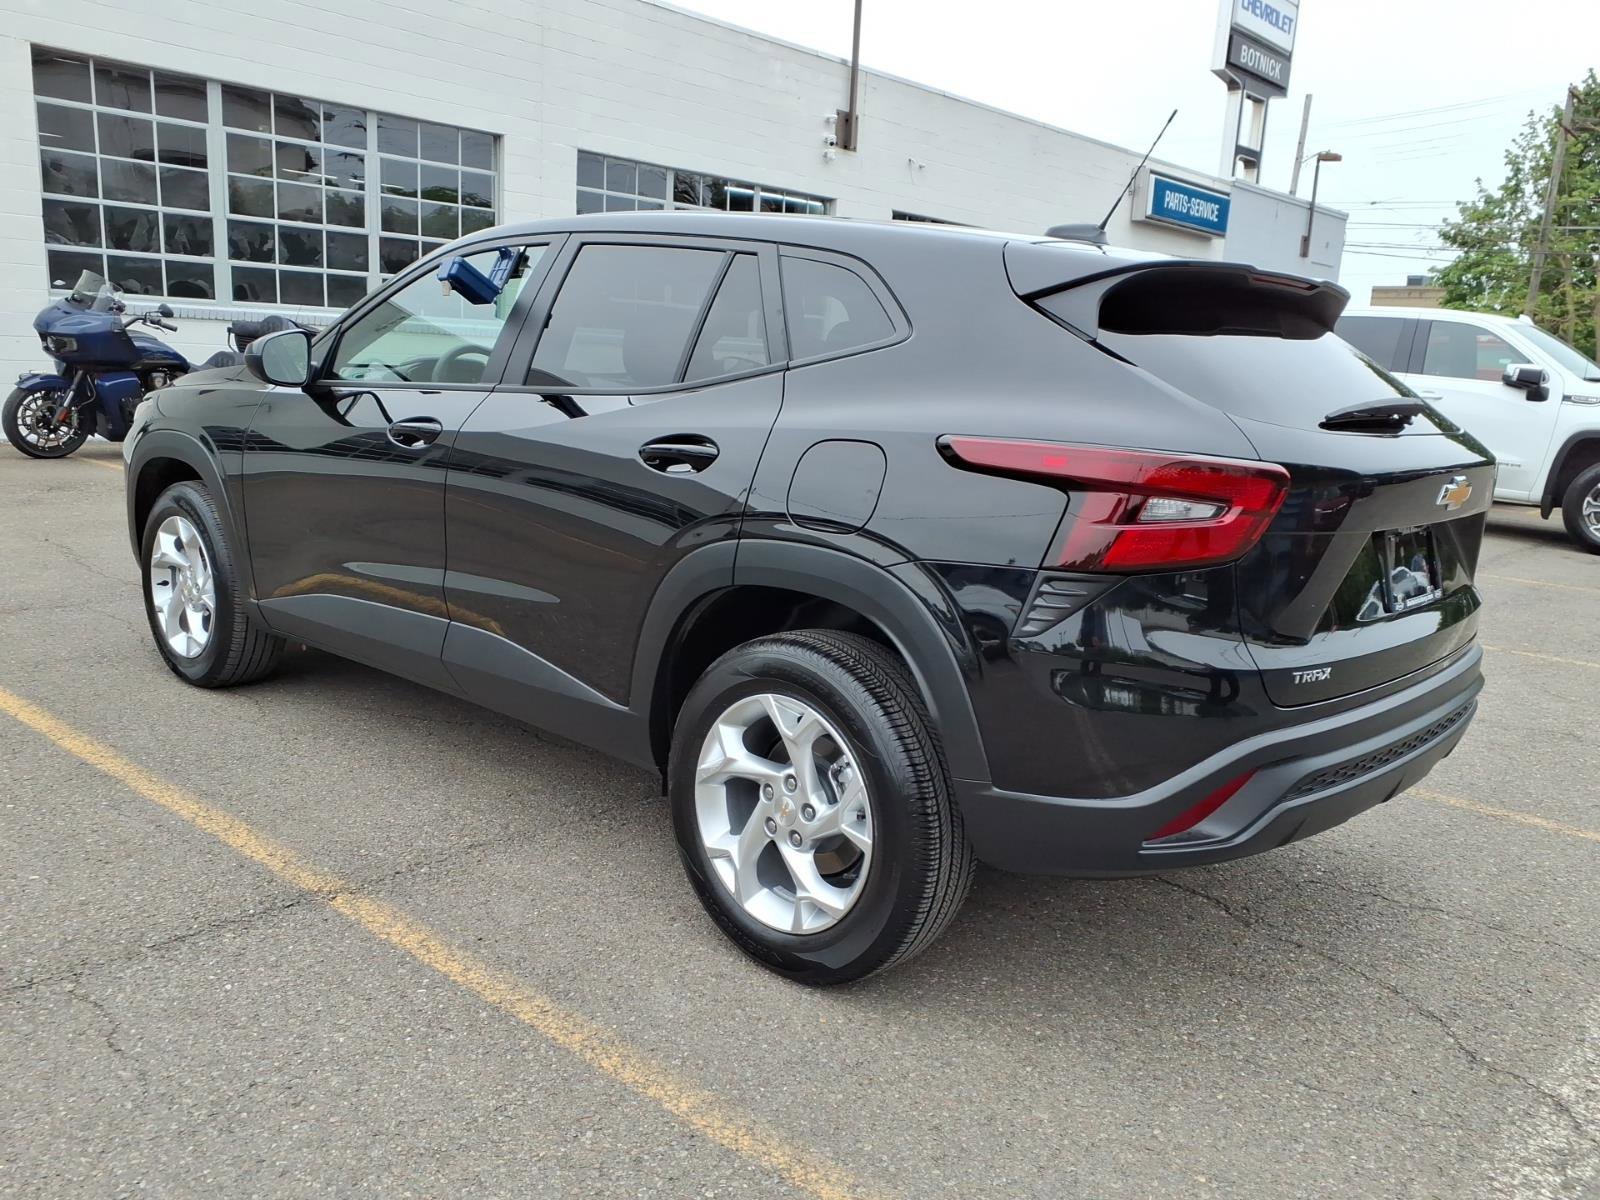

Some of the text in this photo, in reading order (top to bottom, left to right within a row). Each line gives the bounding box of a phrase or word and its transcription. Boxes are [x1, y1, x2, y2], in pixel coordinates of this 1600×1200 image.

[1240, 44, 1282, 79] BOTNICK
[1164, 190, 1220, 222] PARTS-SERVICE
[1292, 667, 1332, 684] TRAX
